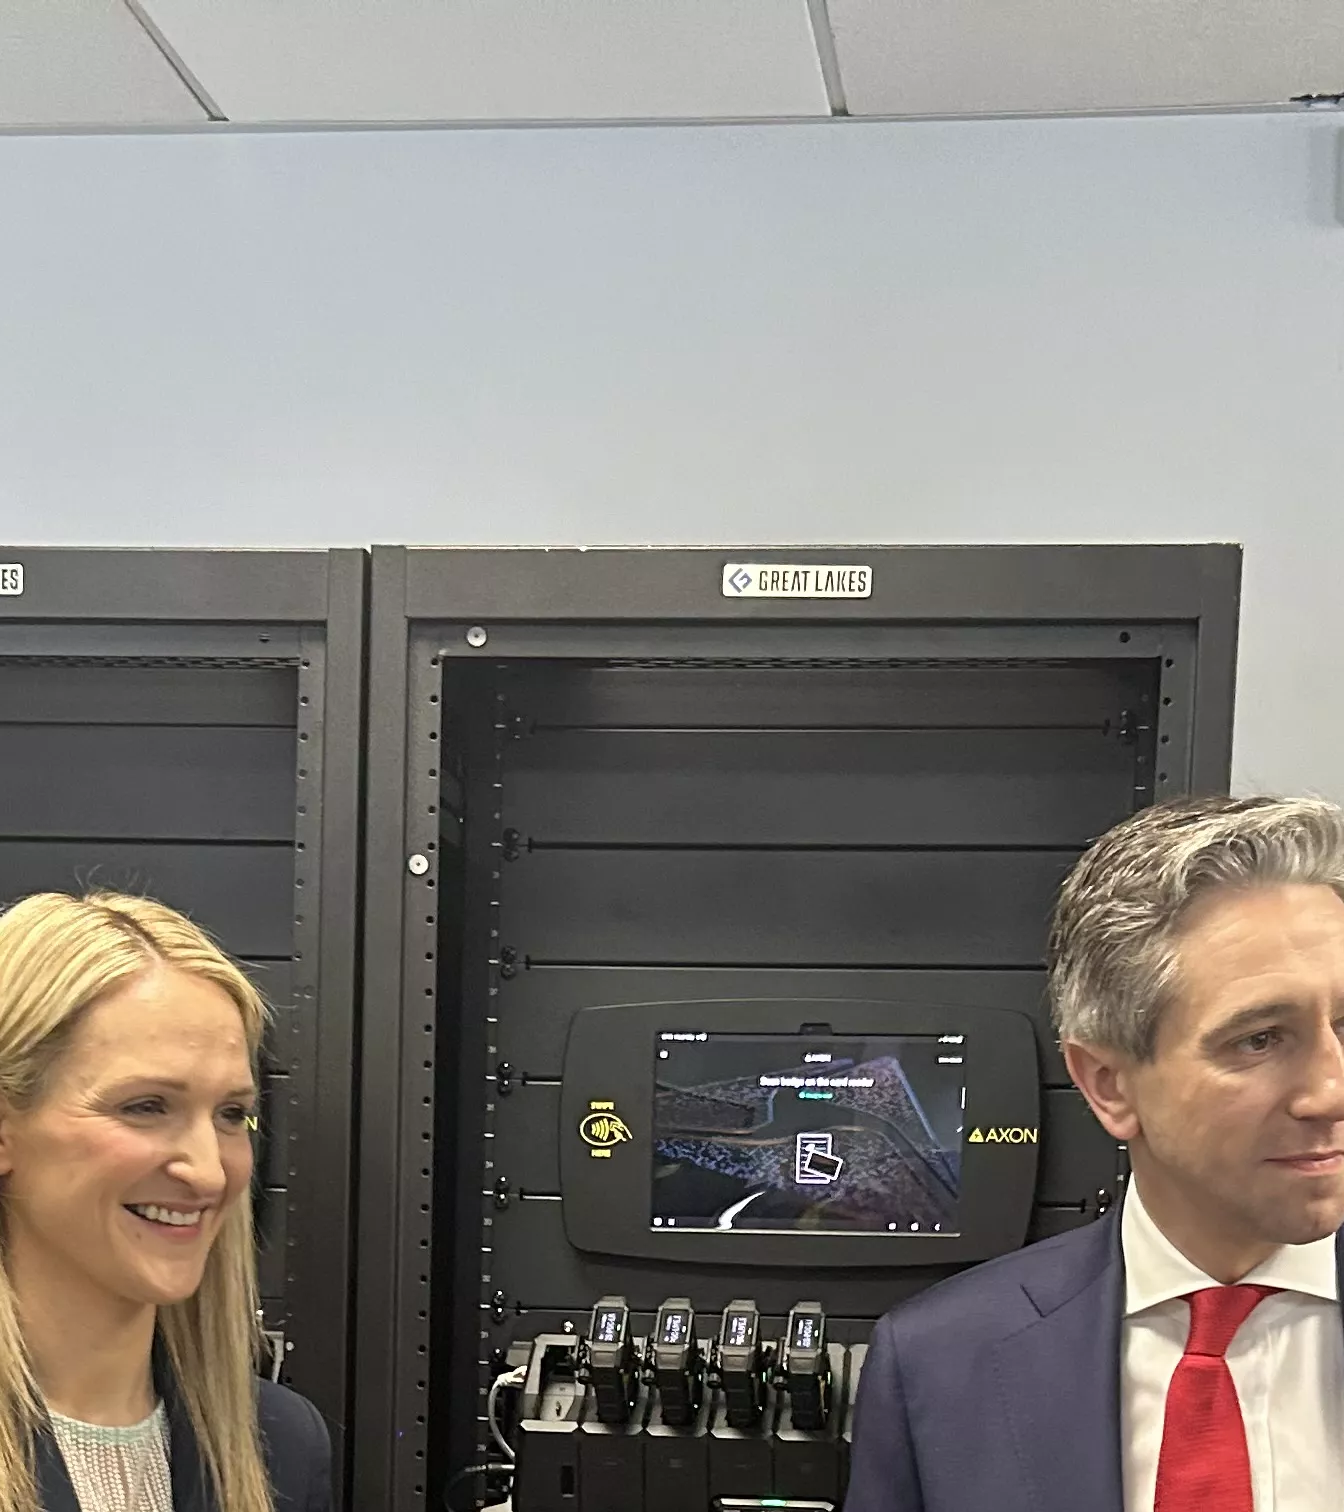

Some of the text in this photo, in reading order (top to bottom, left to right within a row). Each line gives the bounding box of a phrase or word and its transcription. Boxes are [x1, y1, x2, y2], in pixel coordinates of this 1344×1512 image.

[759, 570, 867, 593] GREAT LAKES
[985, 1127, 1038, 1144] AXON
